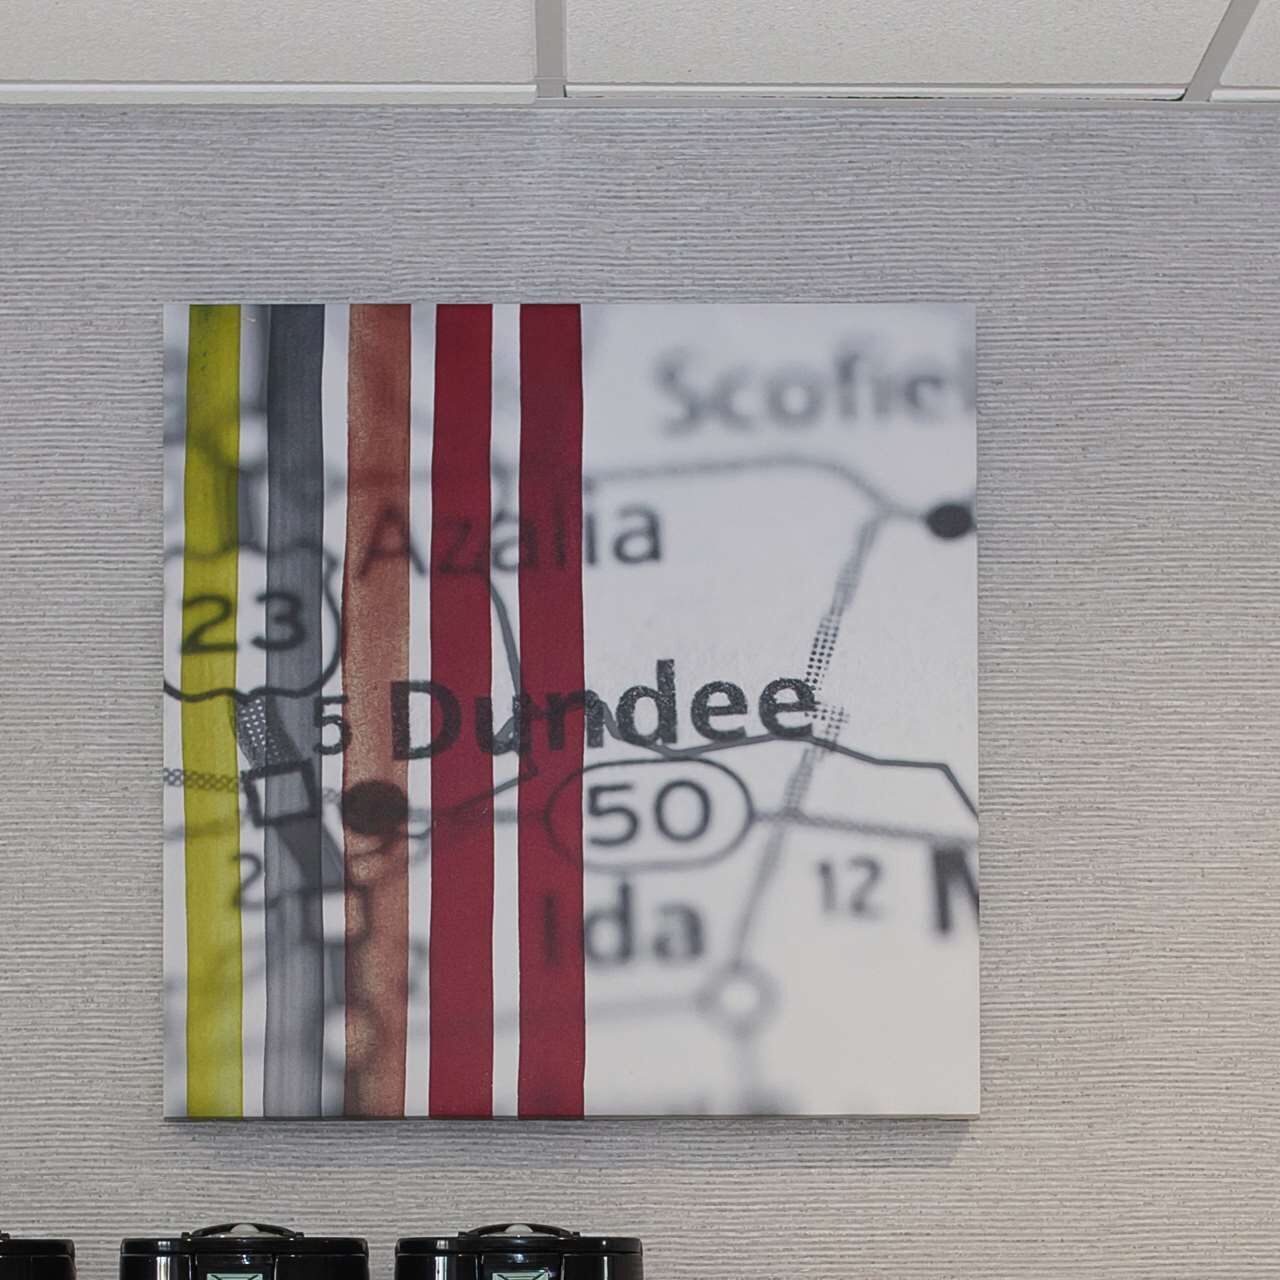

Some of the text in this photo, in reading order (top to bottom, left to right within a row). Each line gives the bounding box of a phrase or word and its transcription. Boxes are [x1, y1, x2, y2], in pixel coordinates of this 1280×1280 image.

[358, 504, 663, 580] Azalia
[179, 594, 308, 654] 23
[391, 660, 817, 762] Dundee
[588, 780, 713, 847] 50
[818, 857, 881, 916] 12
[539, 885, 705, 968] Ida
